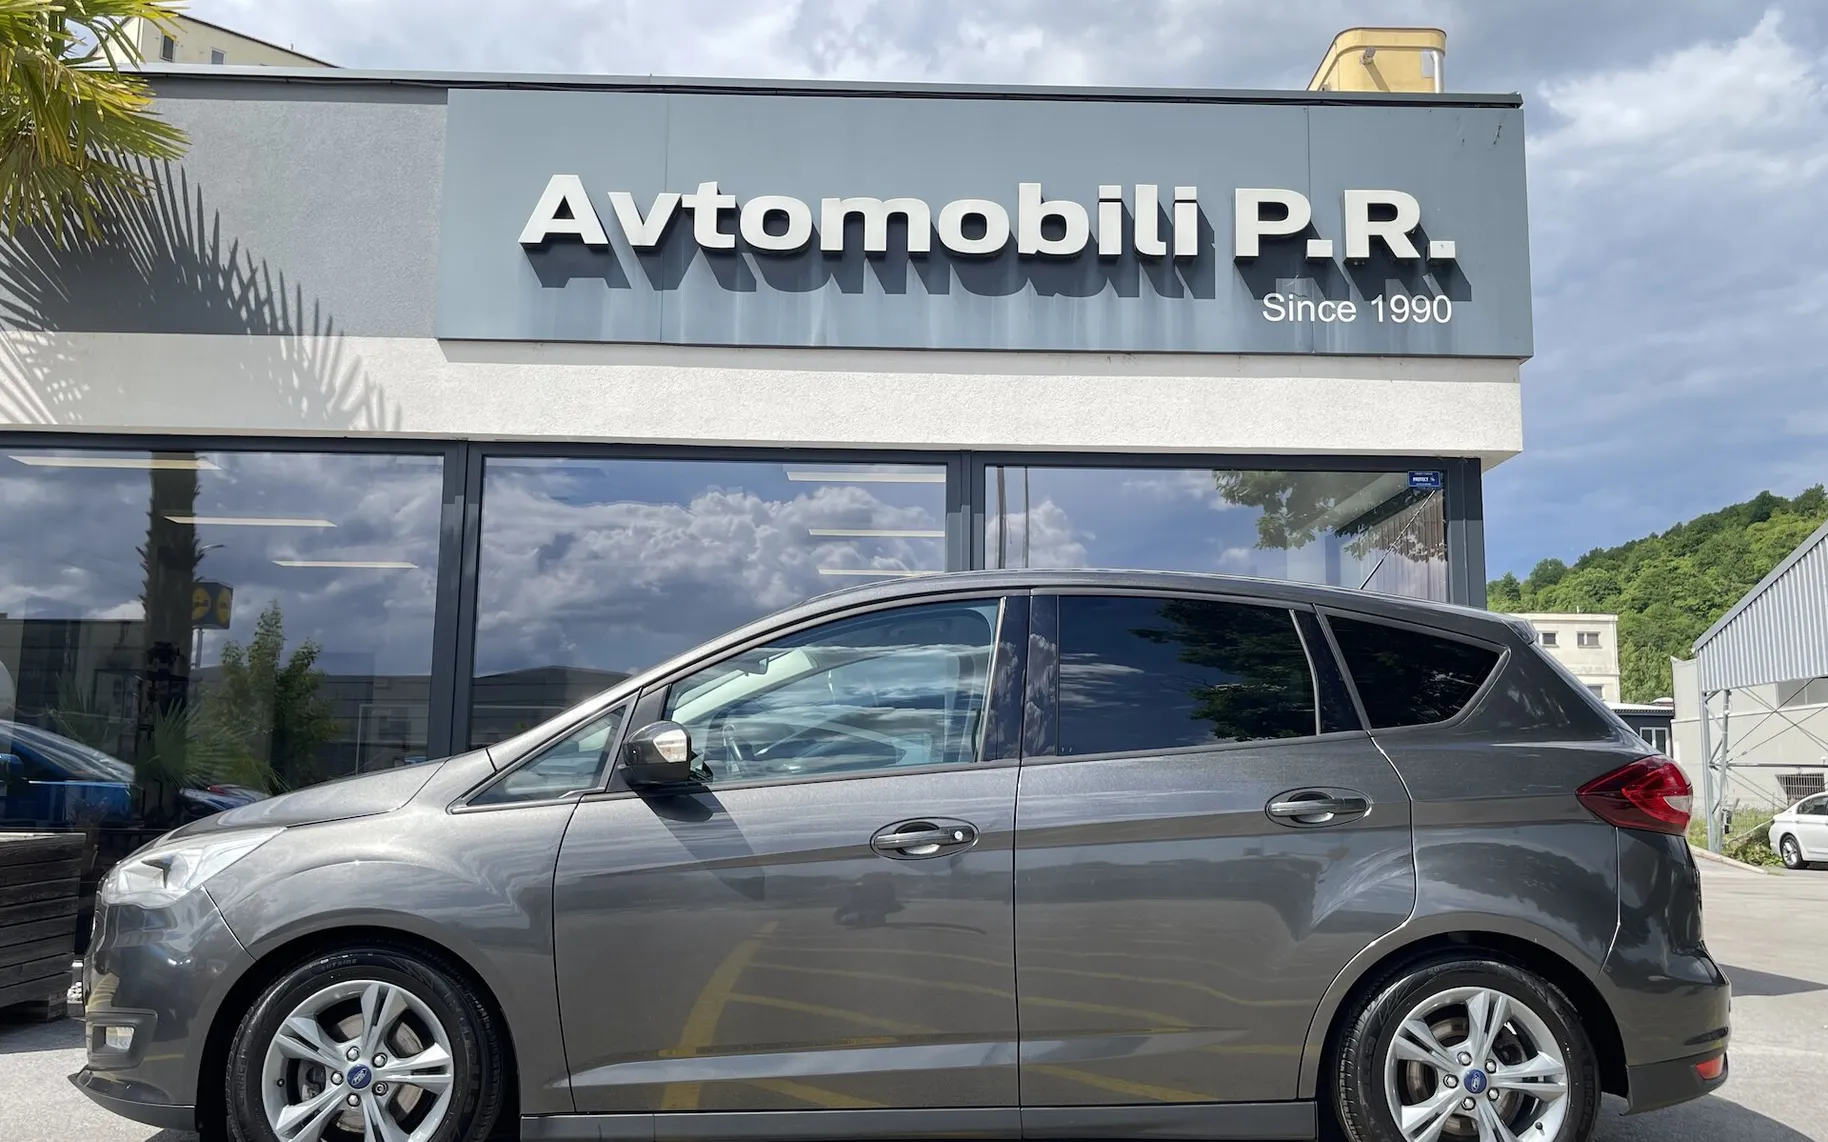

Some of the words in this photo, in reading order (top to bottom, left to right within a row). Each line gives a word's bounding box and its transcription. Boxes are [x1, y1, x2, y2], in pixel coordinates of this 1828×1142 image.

[518, 174, 1198, 258] Avtomobili
[1233, 187, 1457, 260] P.R.
[1262, 293, 1357, 322] Since
[1371, 294, 1452, 323] 1990
